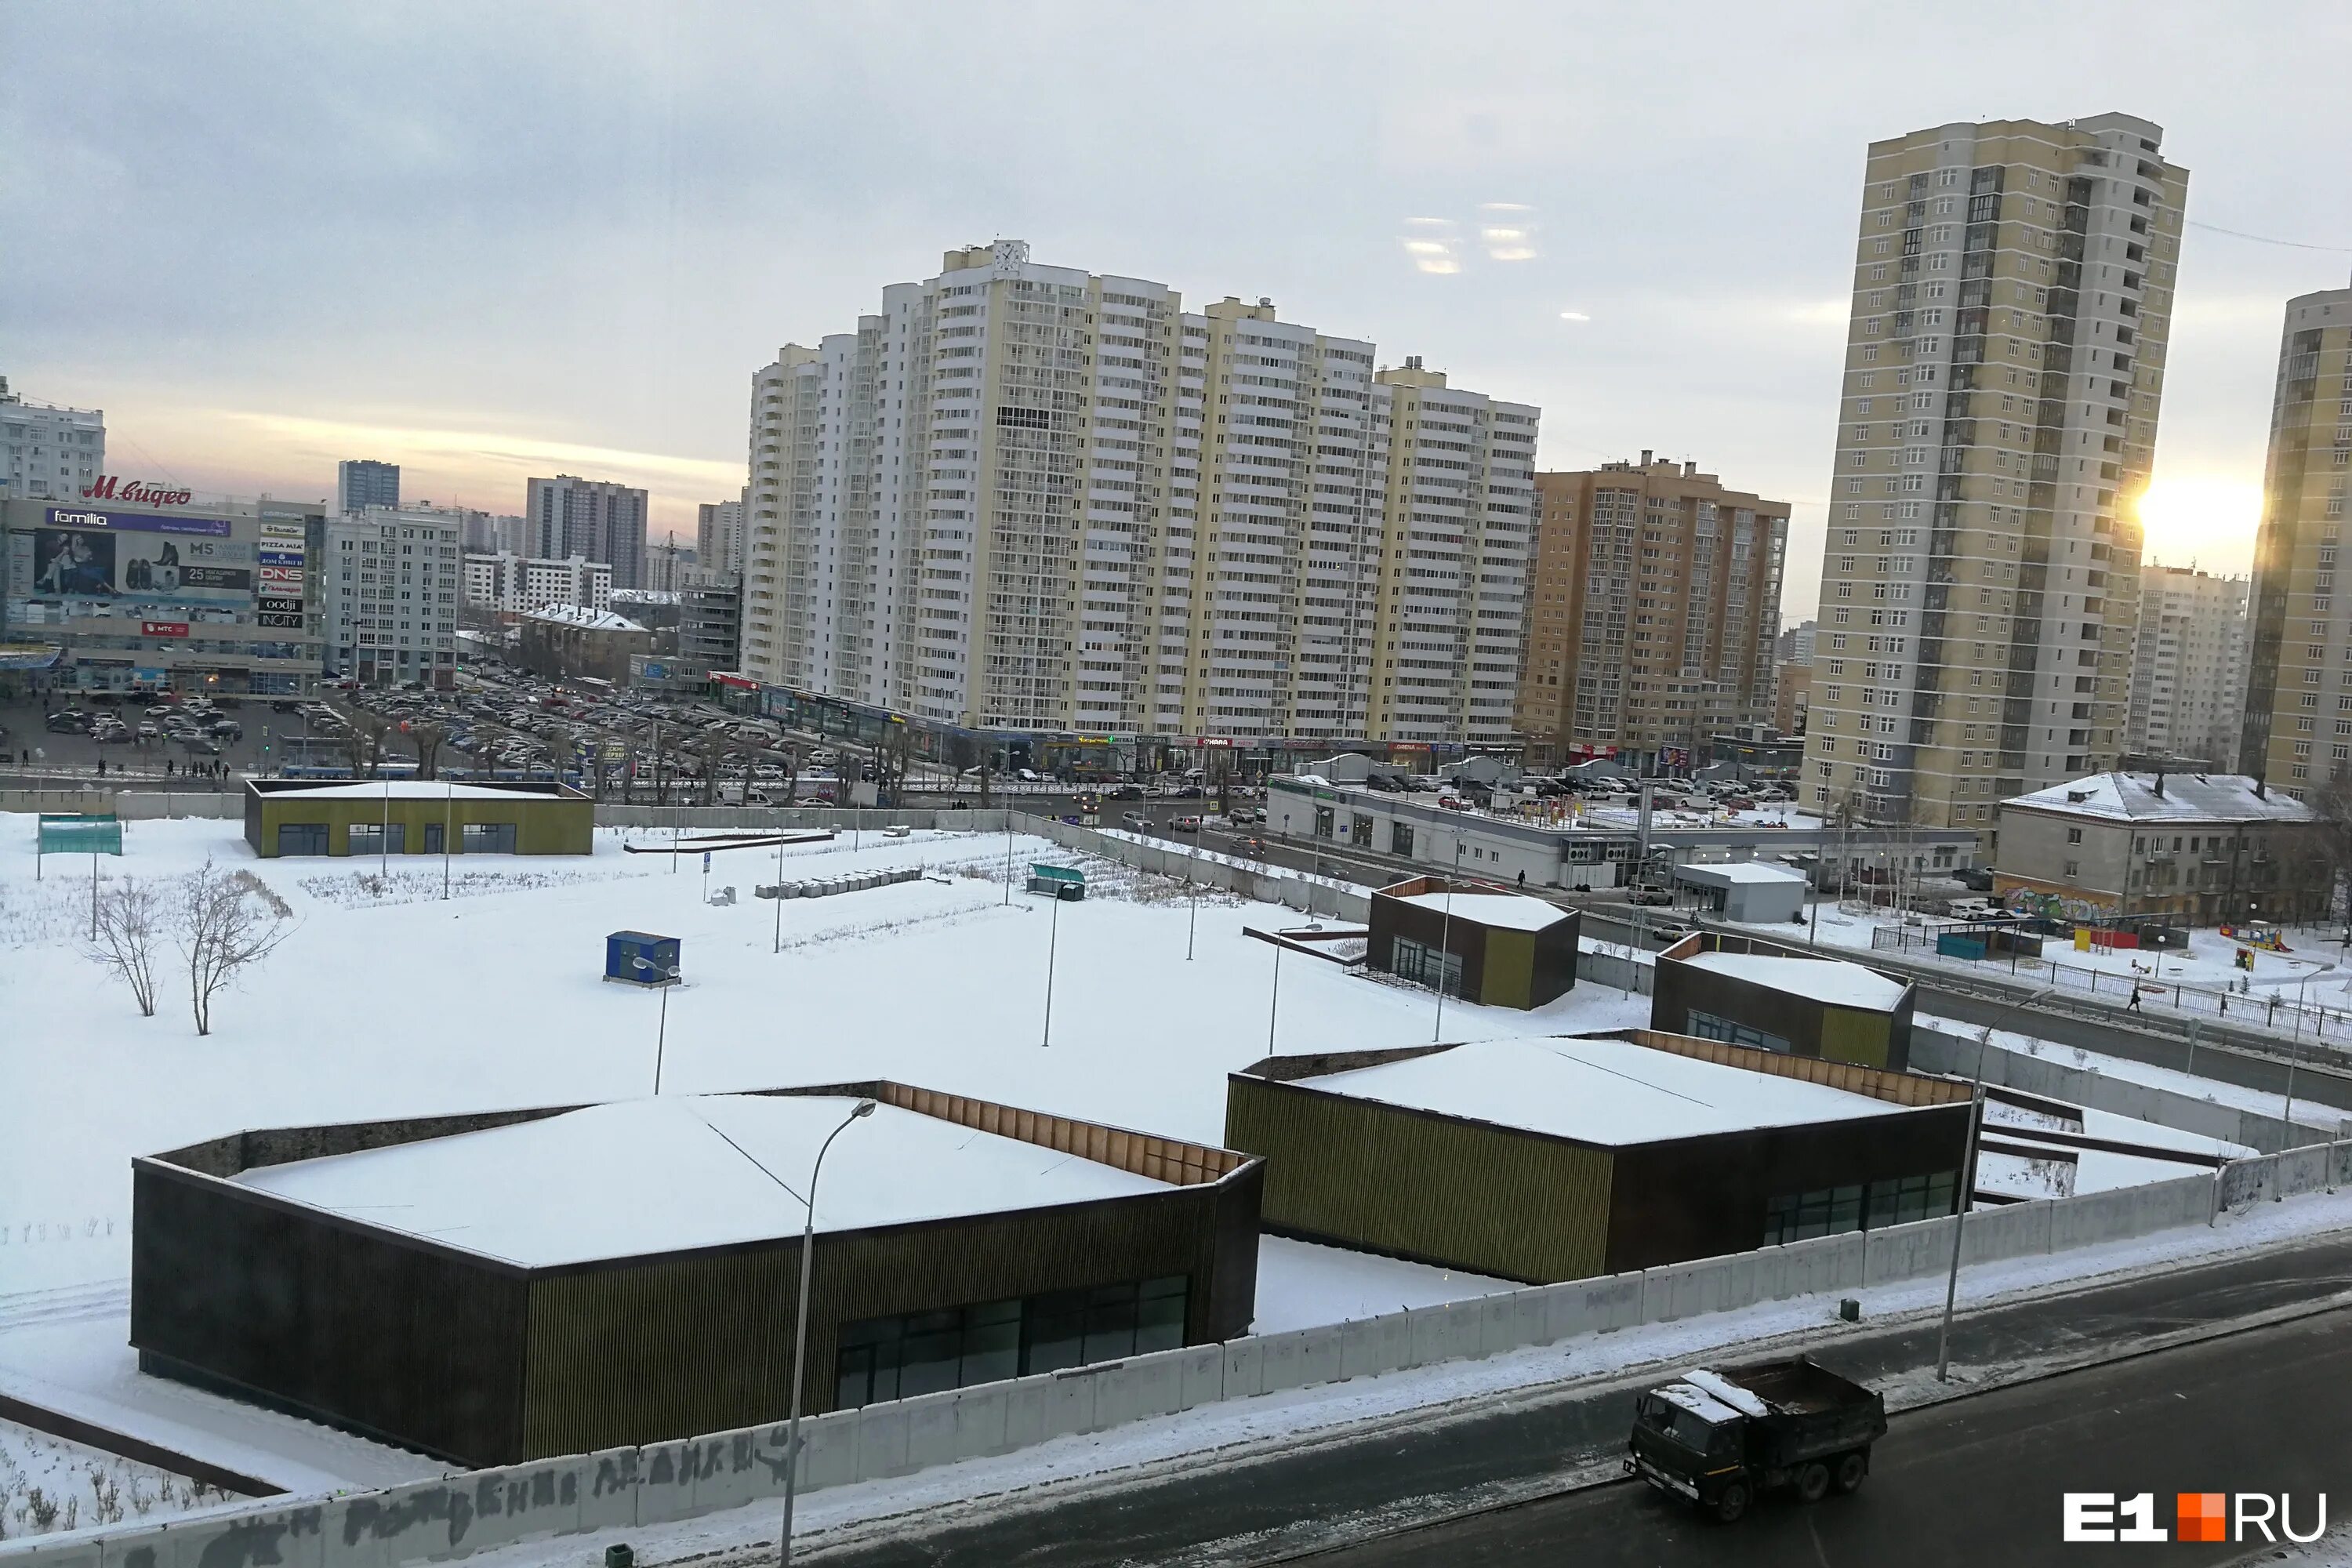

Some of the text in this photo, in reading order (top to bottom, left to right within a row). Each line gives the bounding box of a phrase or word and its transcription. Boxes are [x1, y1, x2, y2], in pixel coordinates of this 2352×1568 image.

[82, 475, 191, 508] М.видео
[55, 510, 107, 525] familia
[189, 568, 204, 580] 25
[260, 568, 303, 580] DNS
[267, 599, 296, 611] oodji
[263, 615, 298, 626] INCITY
